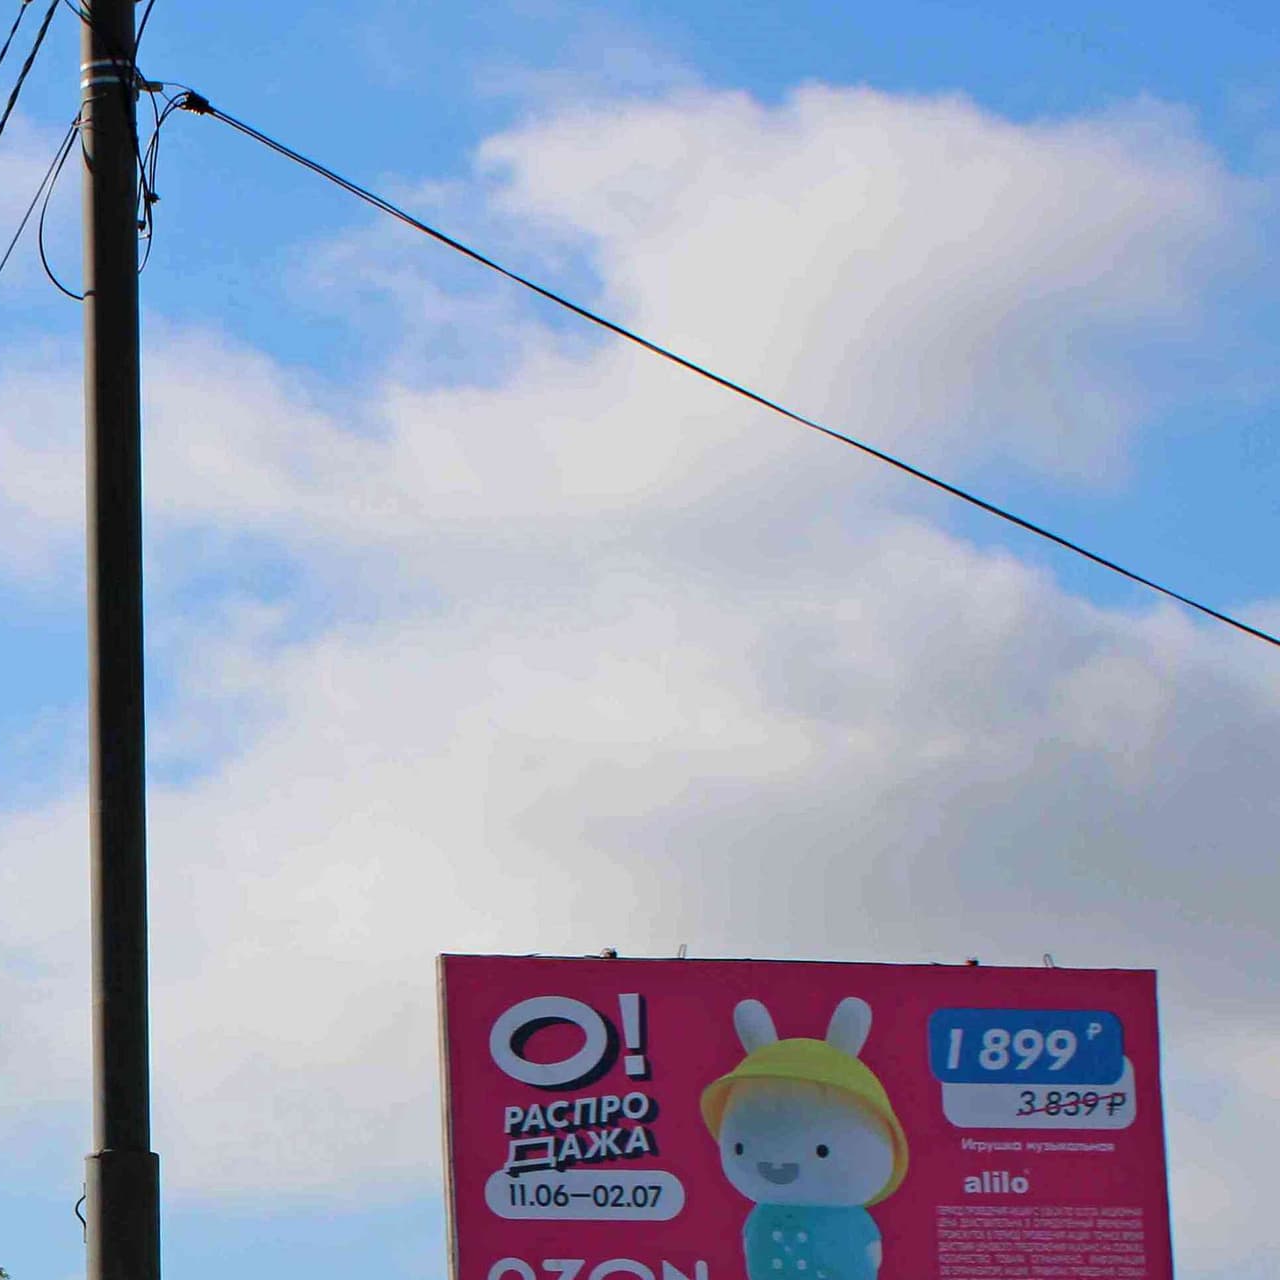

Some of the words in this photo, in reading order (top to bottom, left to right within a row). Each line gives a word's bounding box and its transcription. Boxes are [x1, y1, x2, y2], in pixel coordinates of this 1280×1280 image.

[489, 992, 647, 1087] О!
[504, 1092, 650, 1134] РАСПРО
[503, 1126, 651, 1173] ДАЖА
[964, 1171, 1029, 1194] alilo
